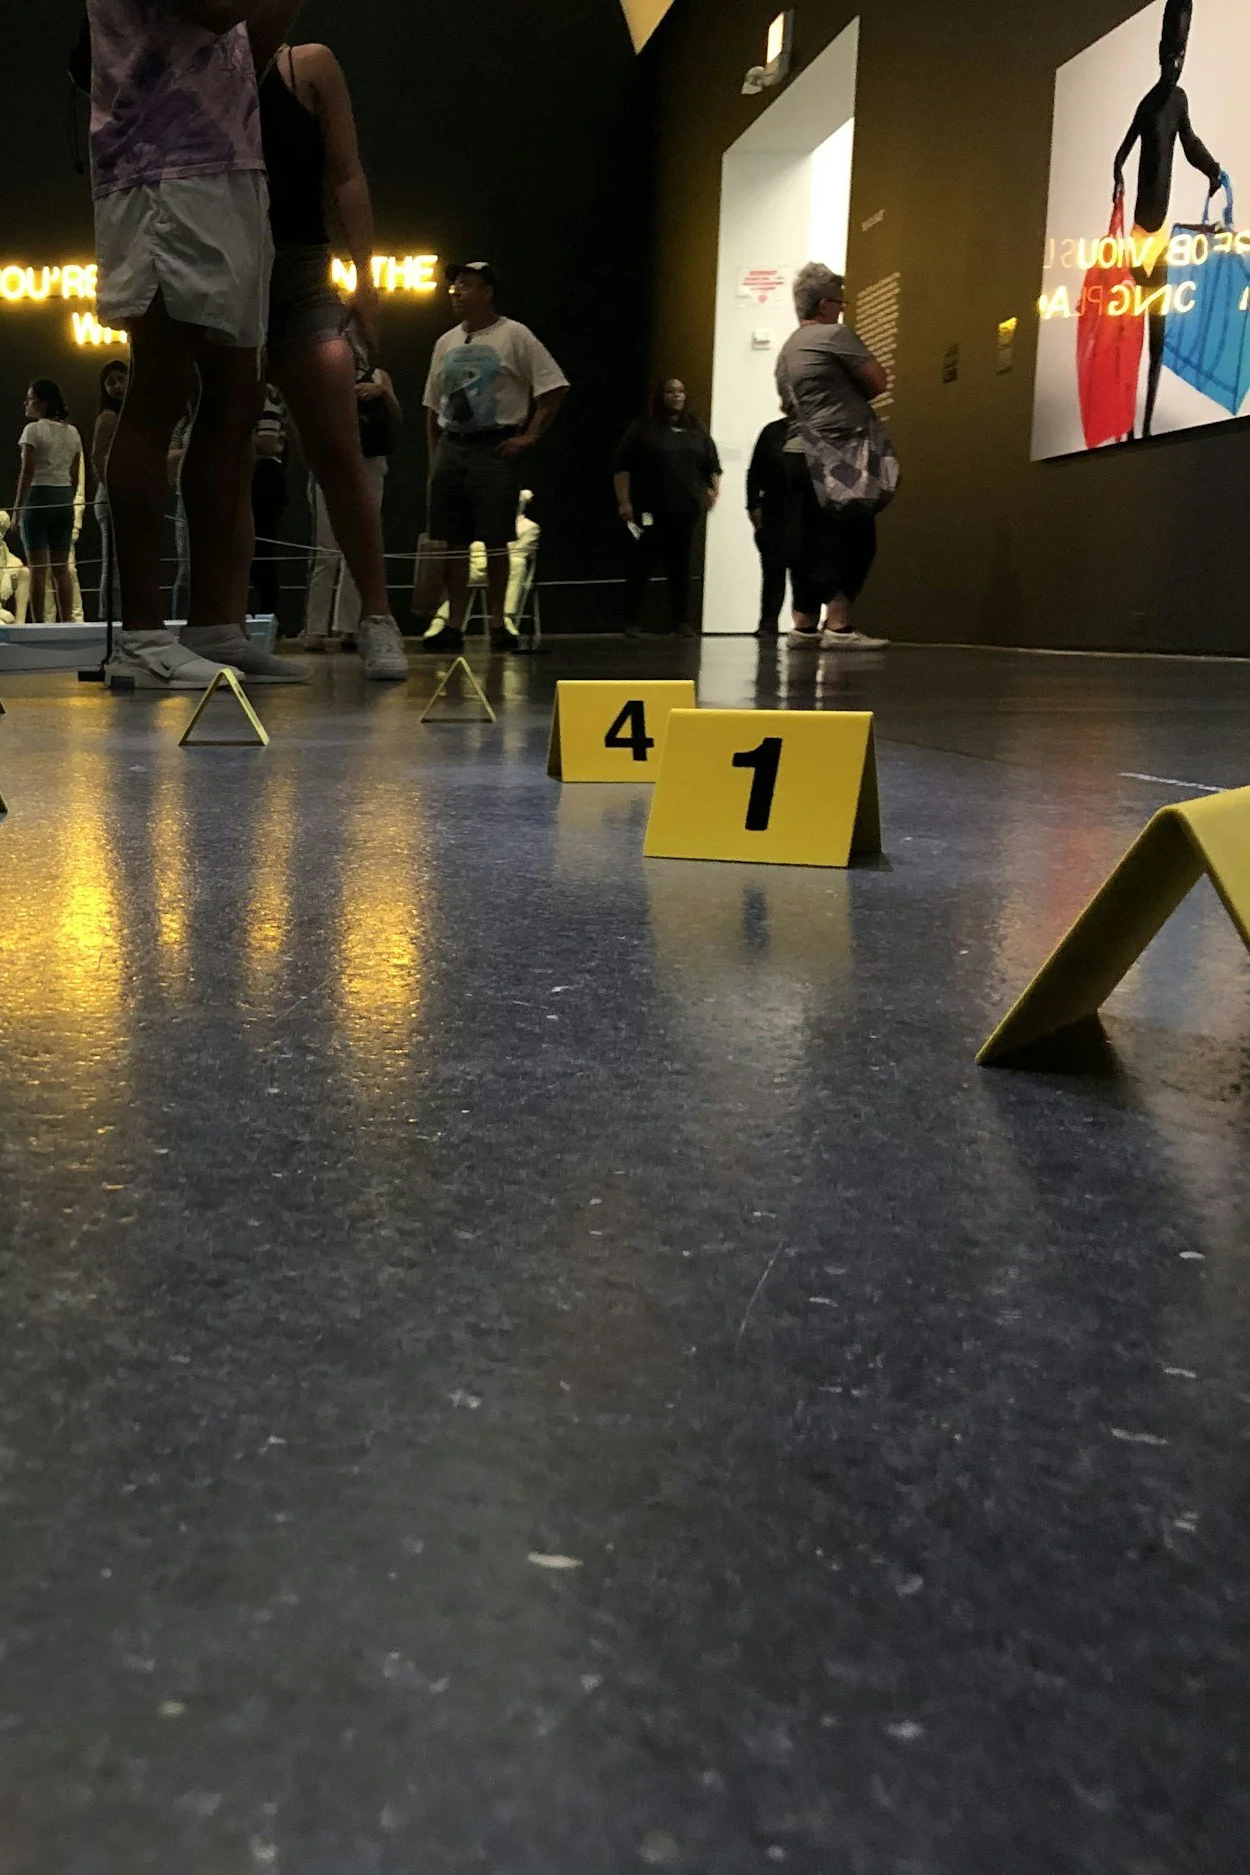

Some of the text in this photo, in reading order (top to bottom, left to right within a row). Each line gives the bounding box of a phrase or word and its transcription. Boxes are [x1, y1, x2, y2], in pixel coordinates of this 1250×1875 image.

[332, 258, 358, 293] N
[371, 255, 439, 292] THE
[605, 700, 655, 762] 4
[732, 737, 783, 832] 1
